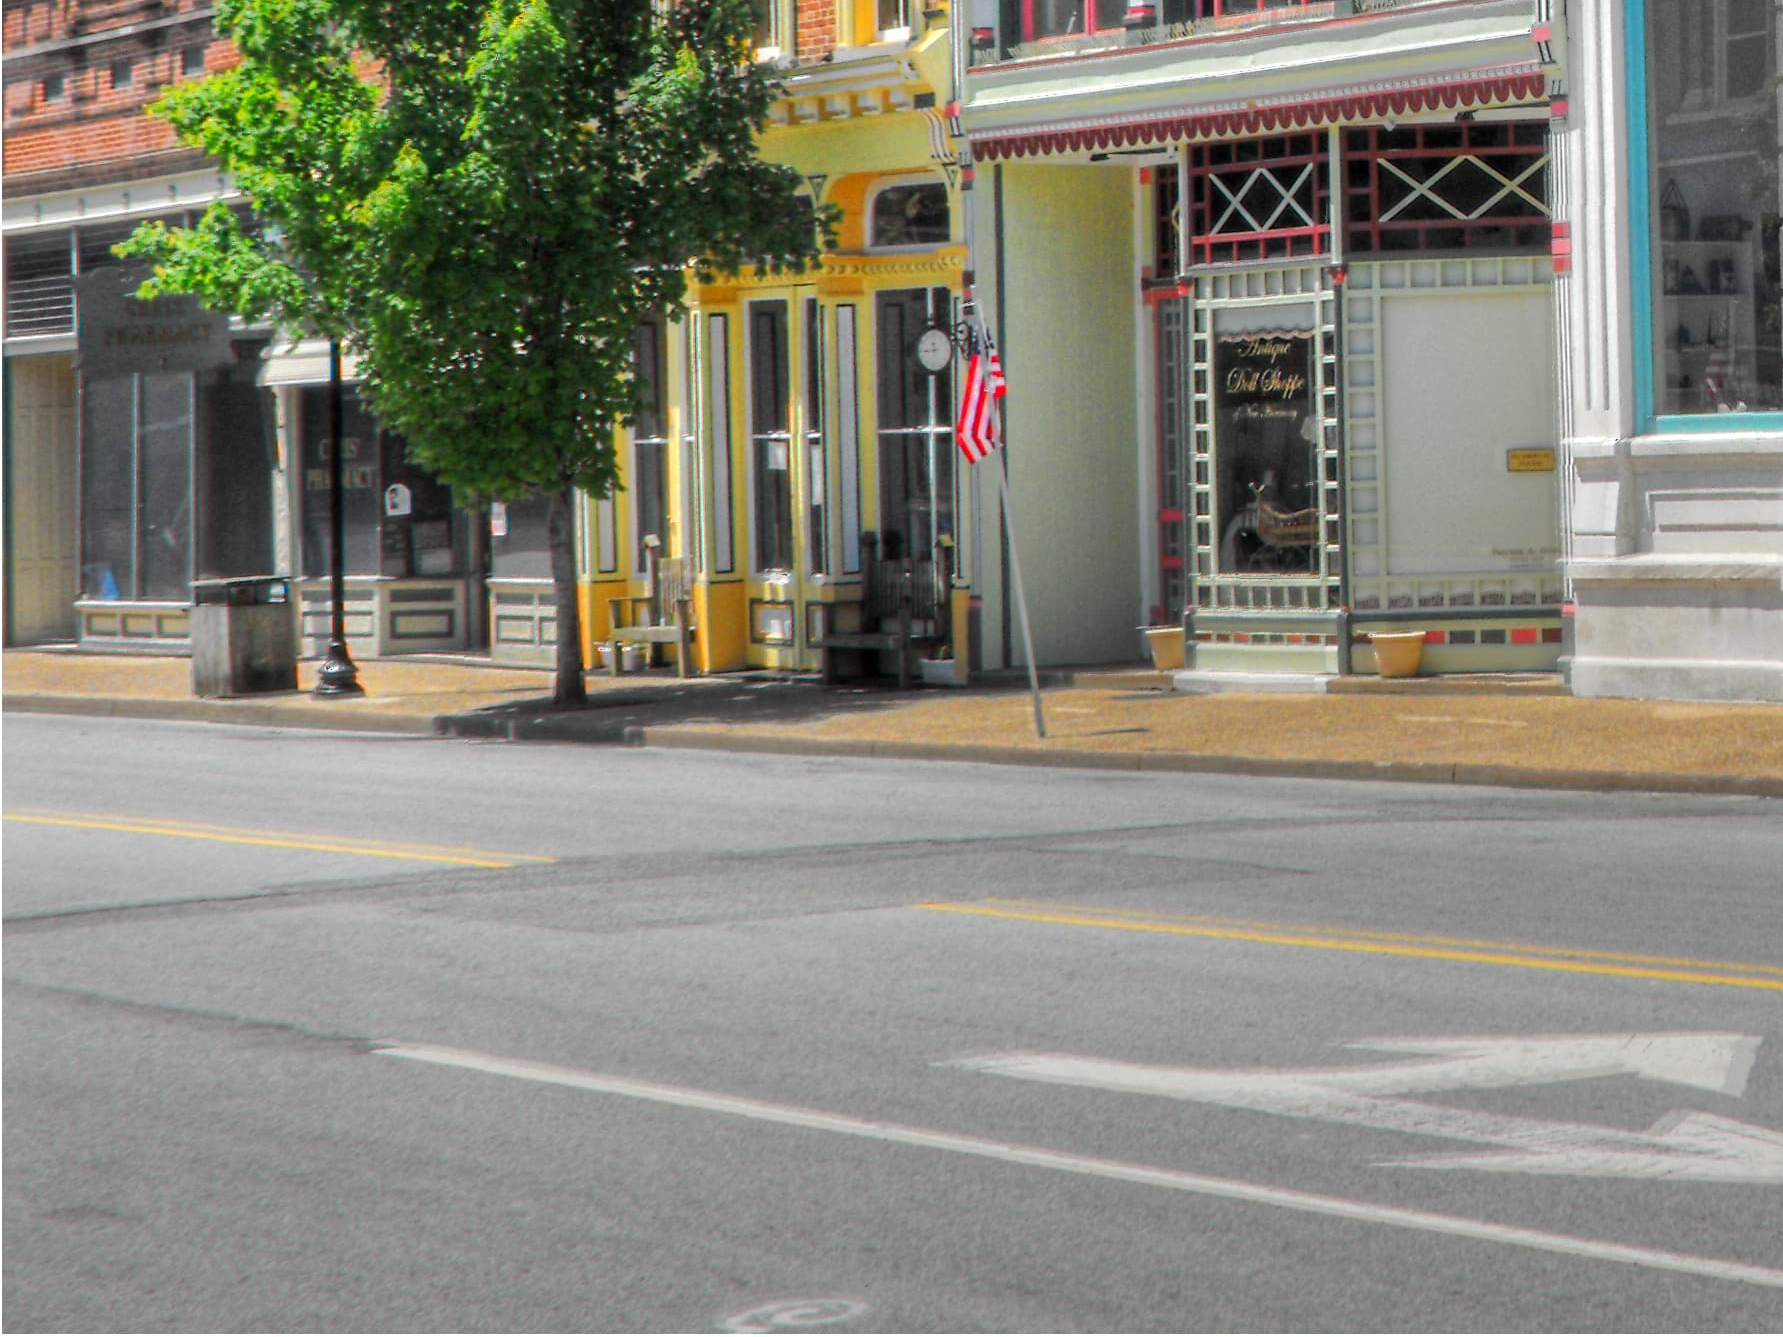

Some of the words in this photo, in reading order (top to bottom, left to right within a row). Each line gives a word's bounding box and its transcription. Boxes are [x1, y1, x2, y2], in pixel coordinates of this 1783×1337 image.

[1238, 338, 1292, 363] Antique
[1225, 366, 1260, 394] Doll
[1260, 365, 1305, 400] Shoppe
